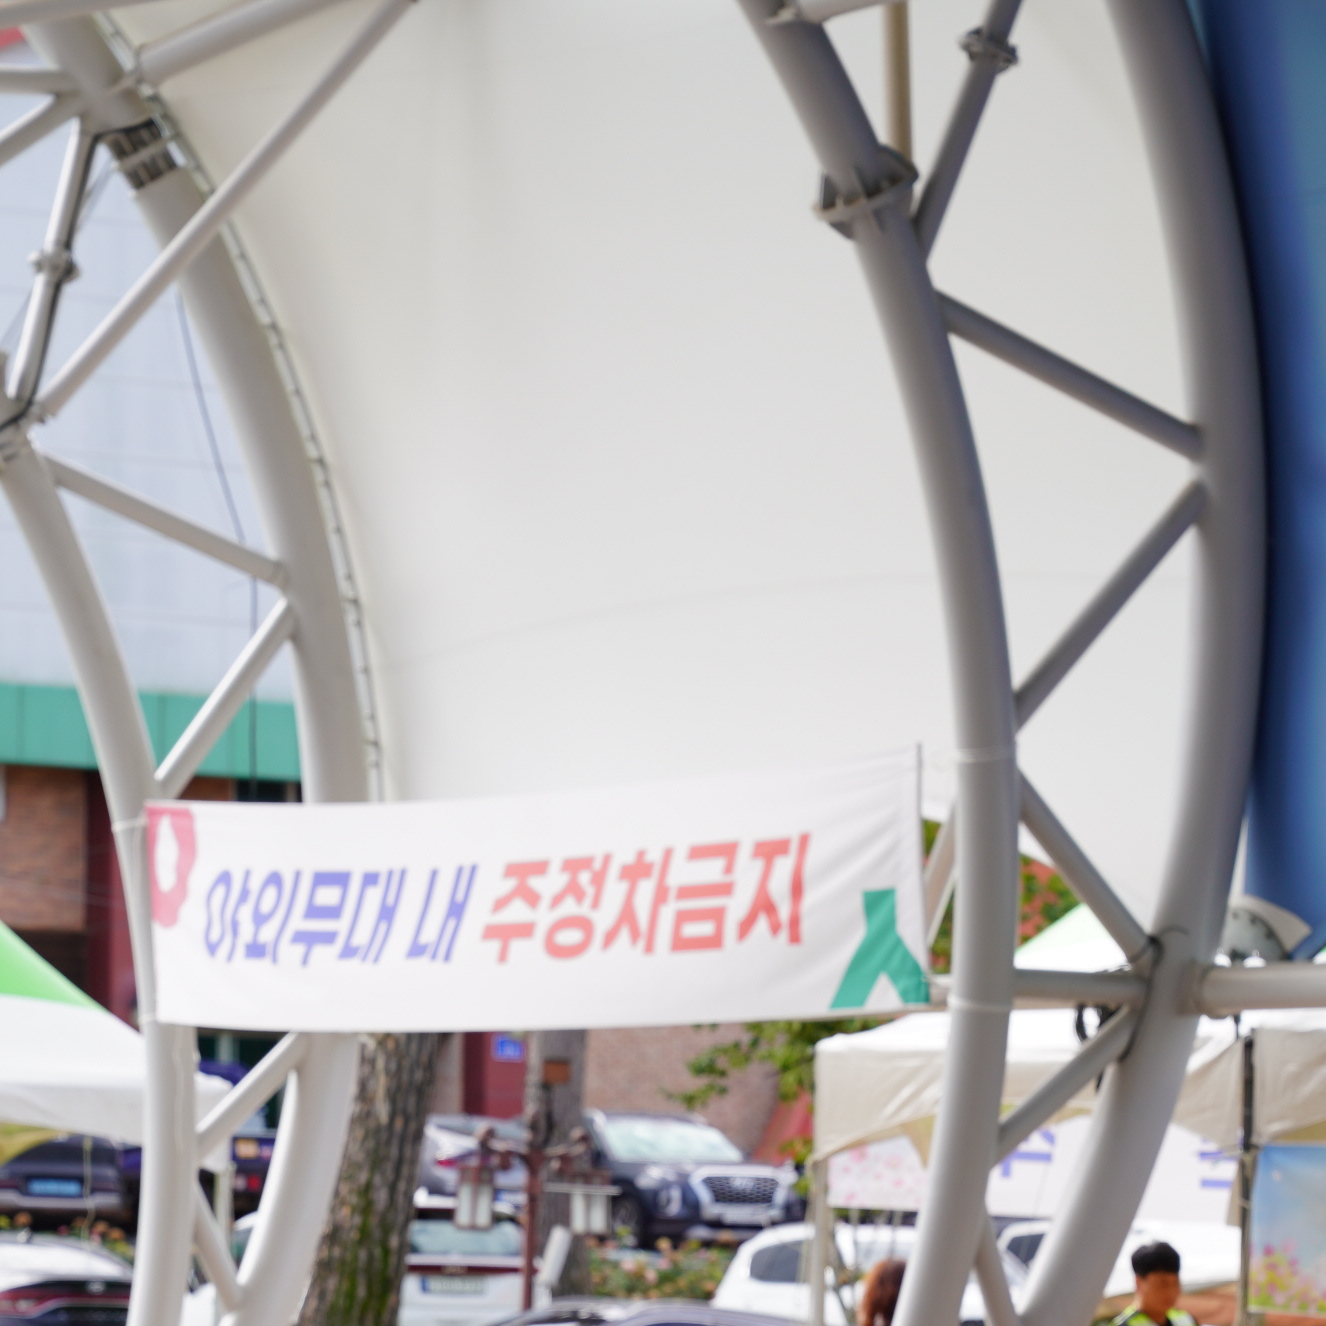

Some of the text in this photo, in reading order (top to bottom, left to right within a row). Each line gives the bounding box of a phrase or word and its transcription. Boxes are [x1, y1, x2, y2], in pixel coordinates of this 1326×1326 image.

[204, 833, 811, 968] 야외무대 내 주정차금지
